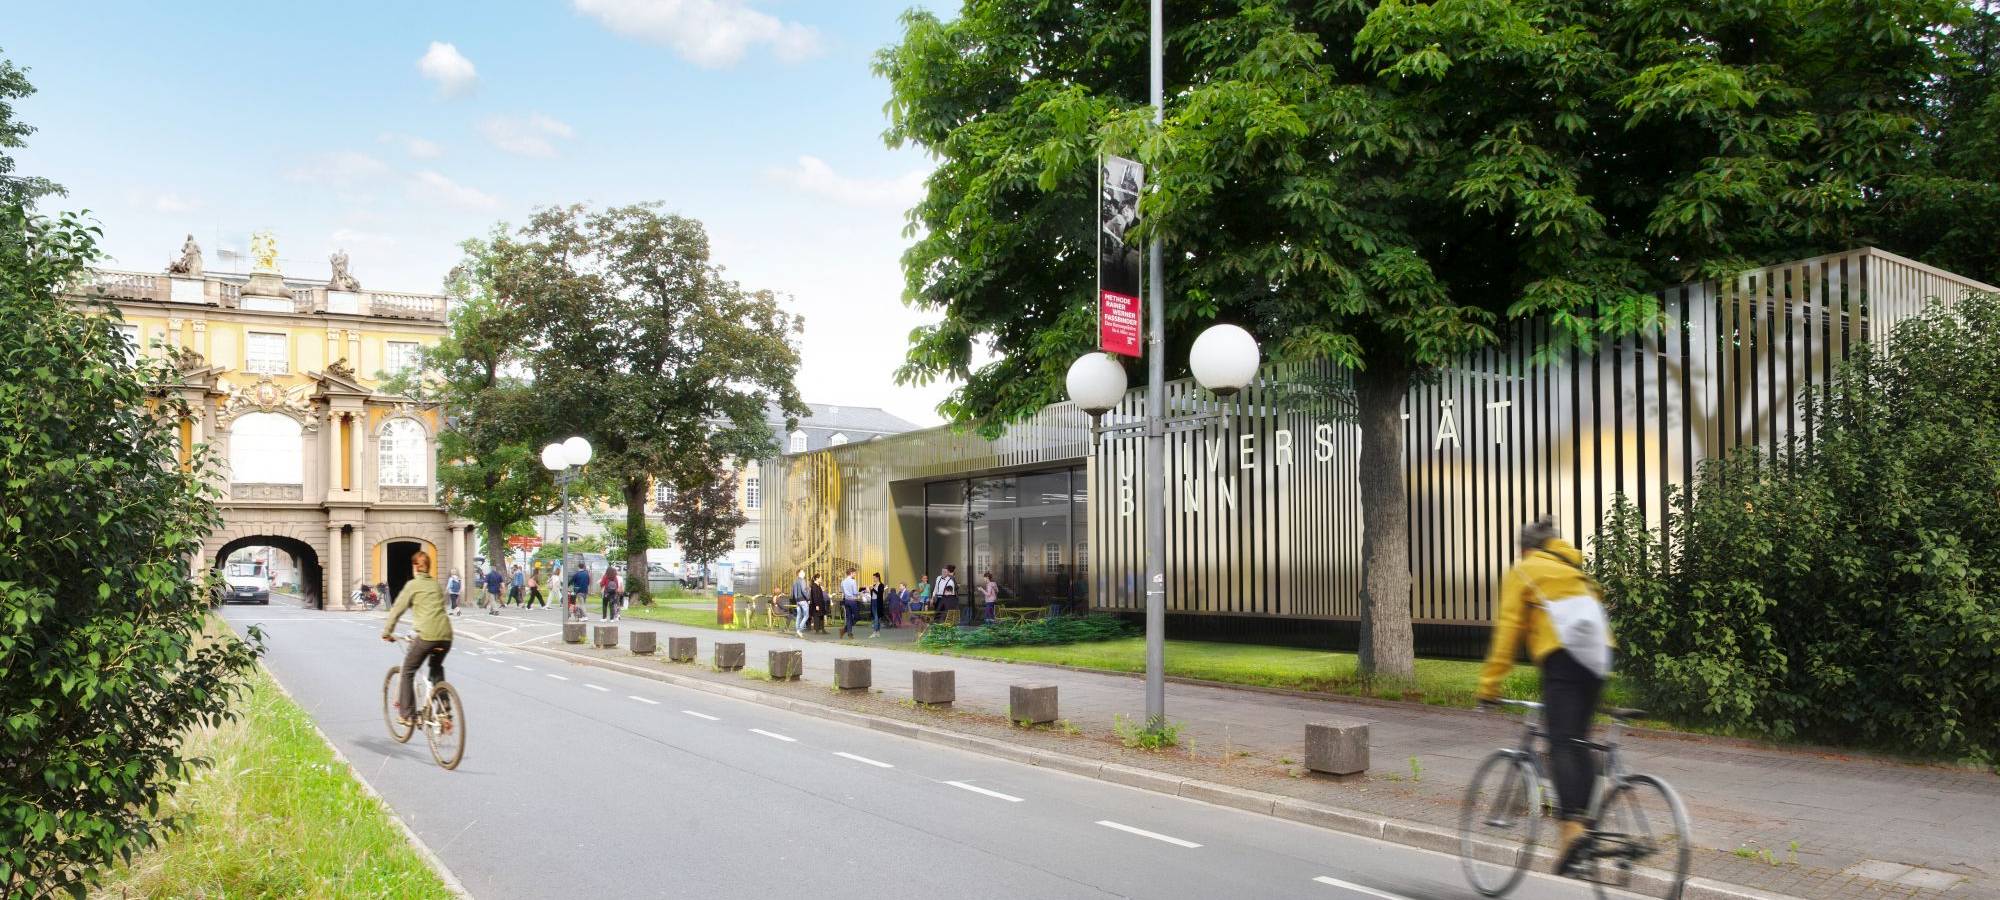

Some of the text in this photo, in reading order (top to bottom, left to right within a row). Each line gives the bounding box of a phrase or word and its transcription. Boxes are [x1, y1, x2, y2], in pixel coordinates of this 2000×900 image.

[1104, 293, 1131, 305] METHODE
[1105, 301, 1126, 310] RAINER
[1104, 313, 1137, 326] FASSBINDER
[1113, 309, 1136, 319] WERNER
[1121, 399, 1511, 480] UIVERSÄT
[1121, 476, 1236, 517] BNN
